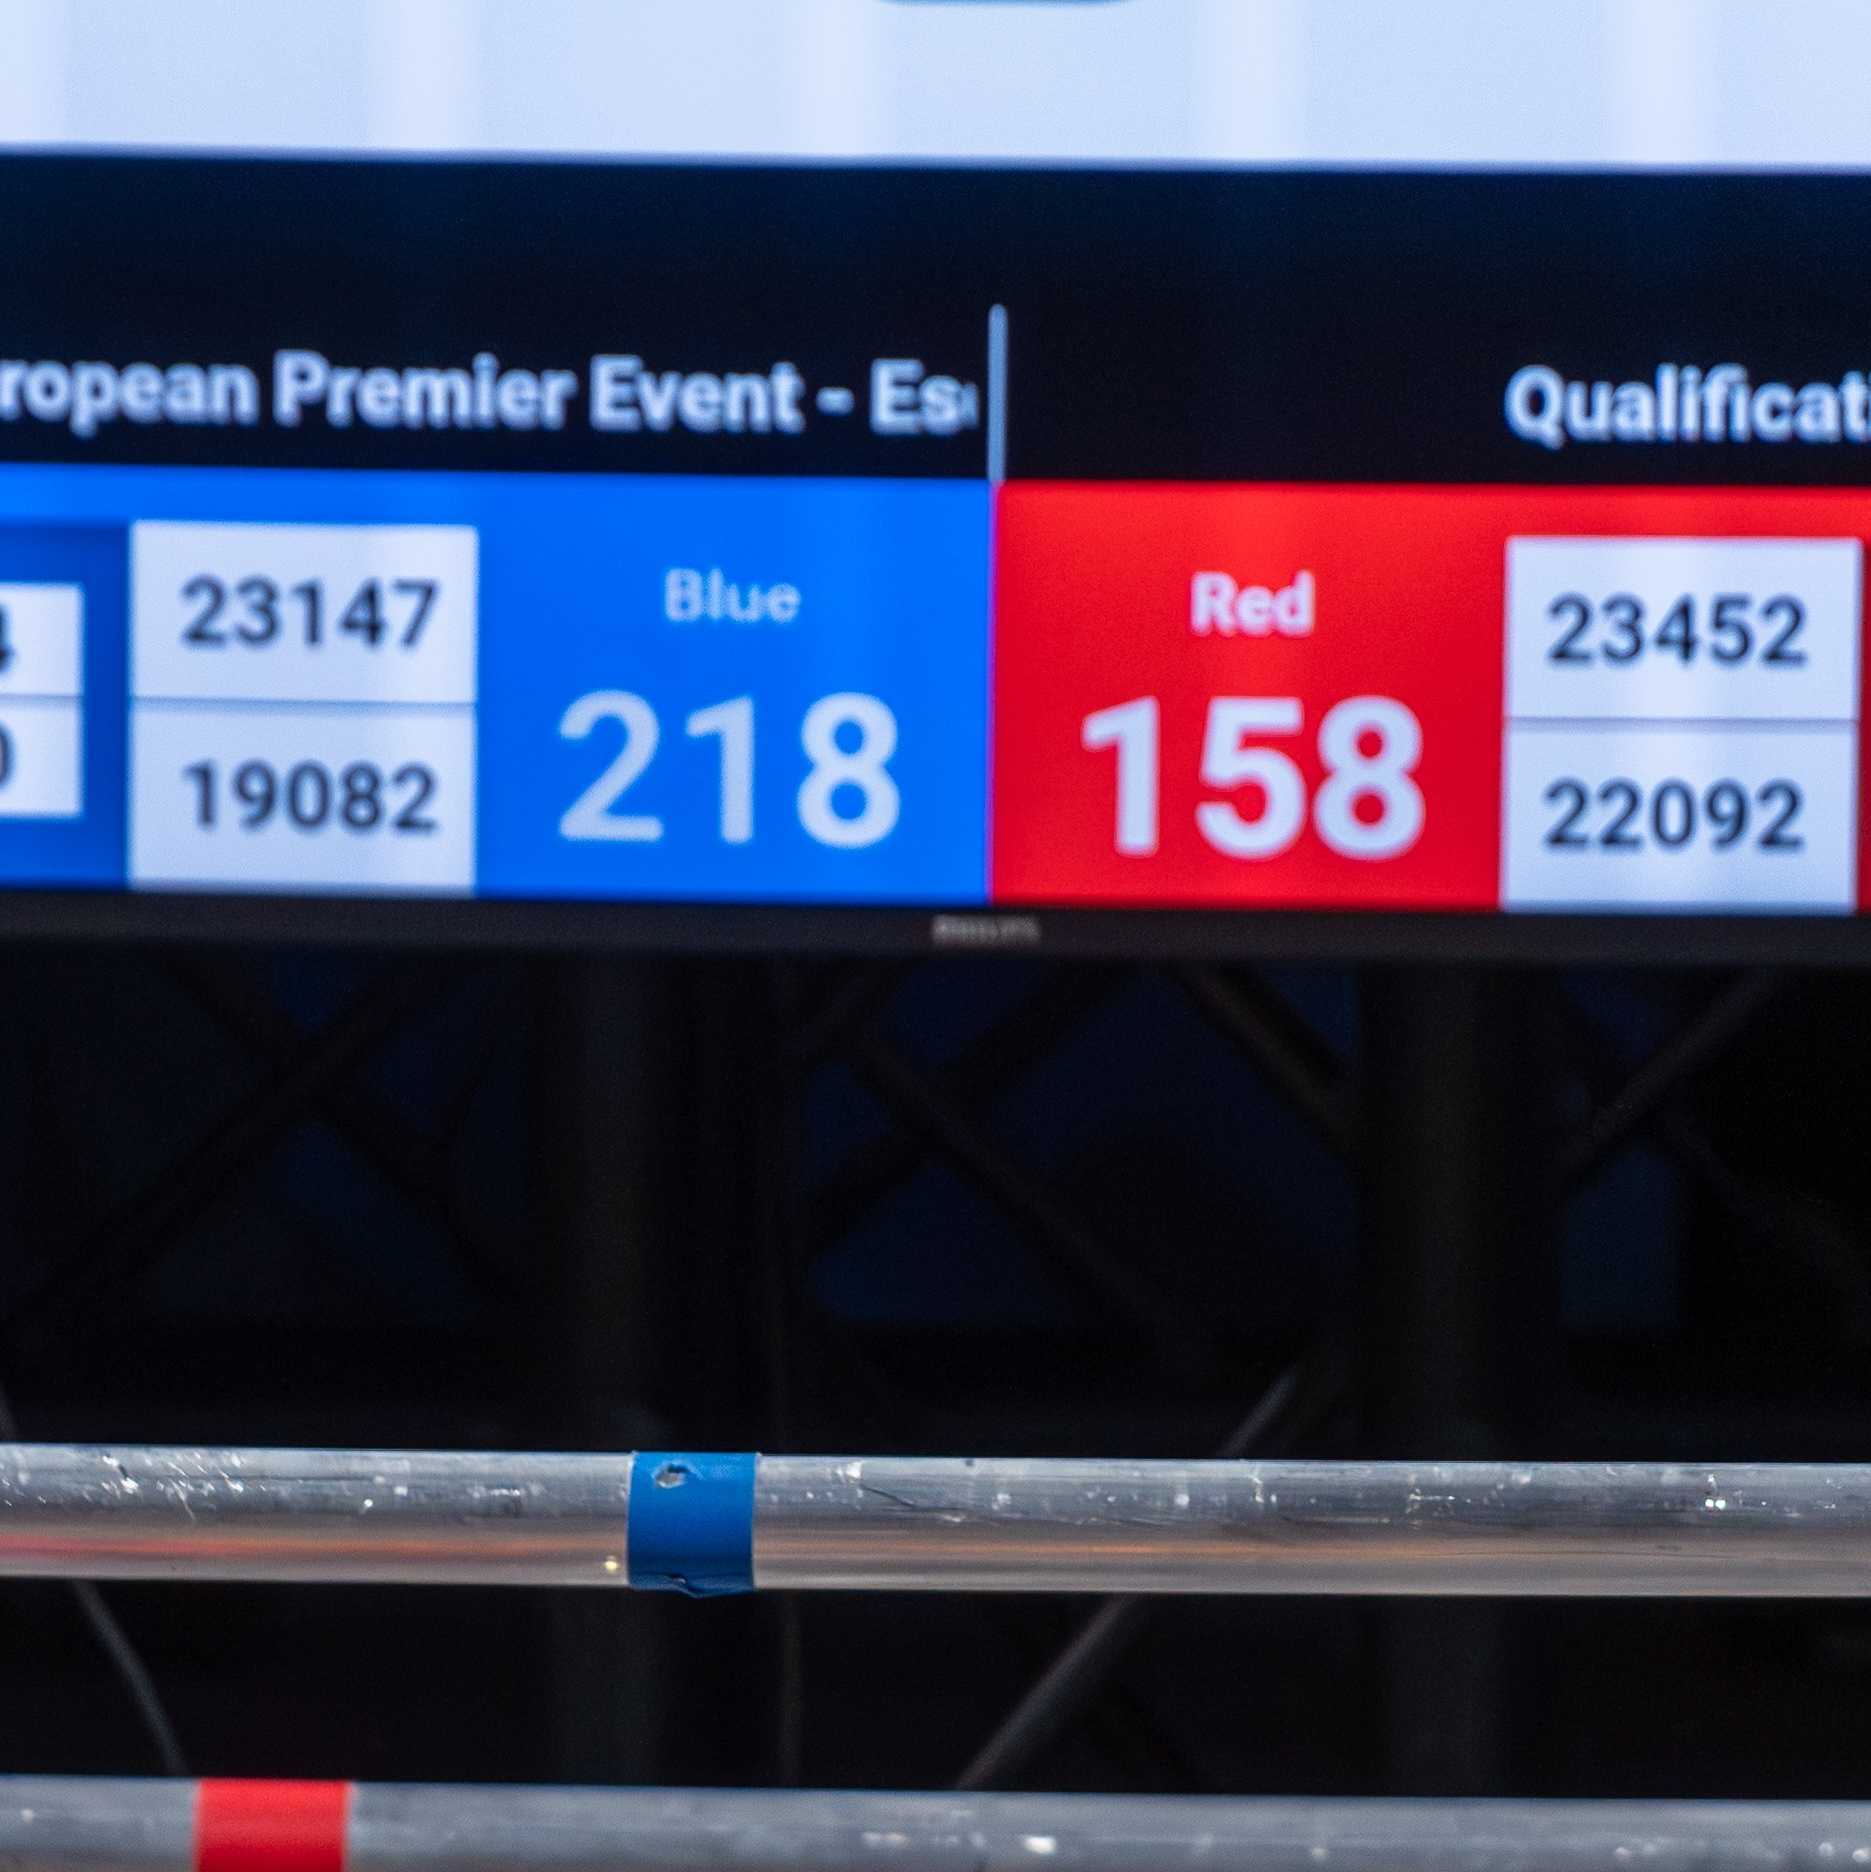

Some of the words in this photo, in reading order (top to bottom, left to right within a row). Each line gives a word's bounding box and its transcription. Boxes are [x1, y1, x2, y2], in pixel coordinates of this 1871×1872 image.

[274, 349, 576, 429] Premier
[589, 354, 804, 434] Event
[181, 575, 438, 649] 23147
[663, 567, 801, 624] Blue
[1190, 571, 1315, 635] Red
[1547, 594, 1806, 667] 23452
[185, 759, 438, 836] 19082
[559, 690, 901, 848] 218
[1081, 694, 1425, 860] 158
[1544, 777, 1804, 853] 22092
